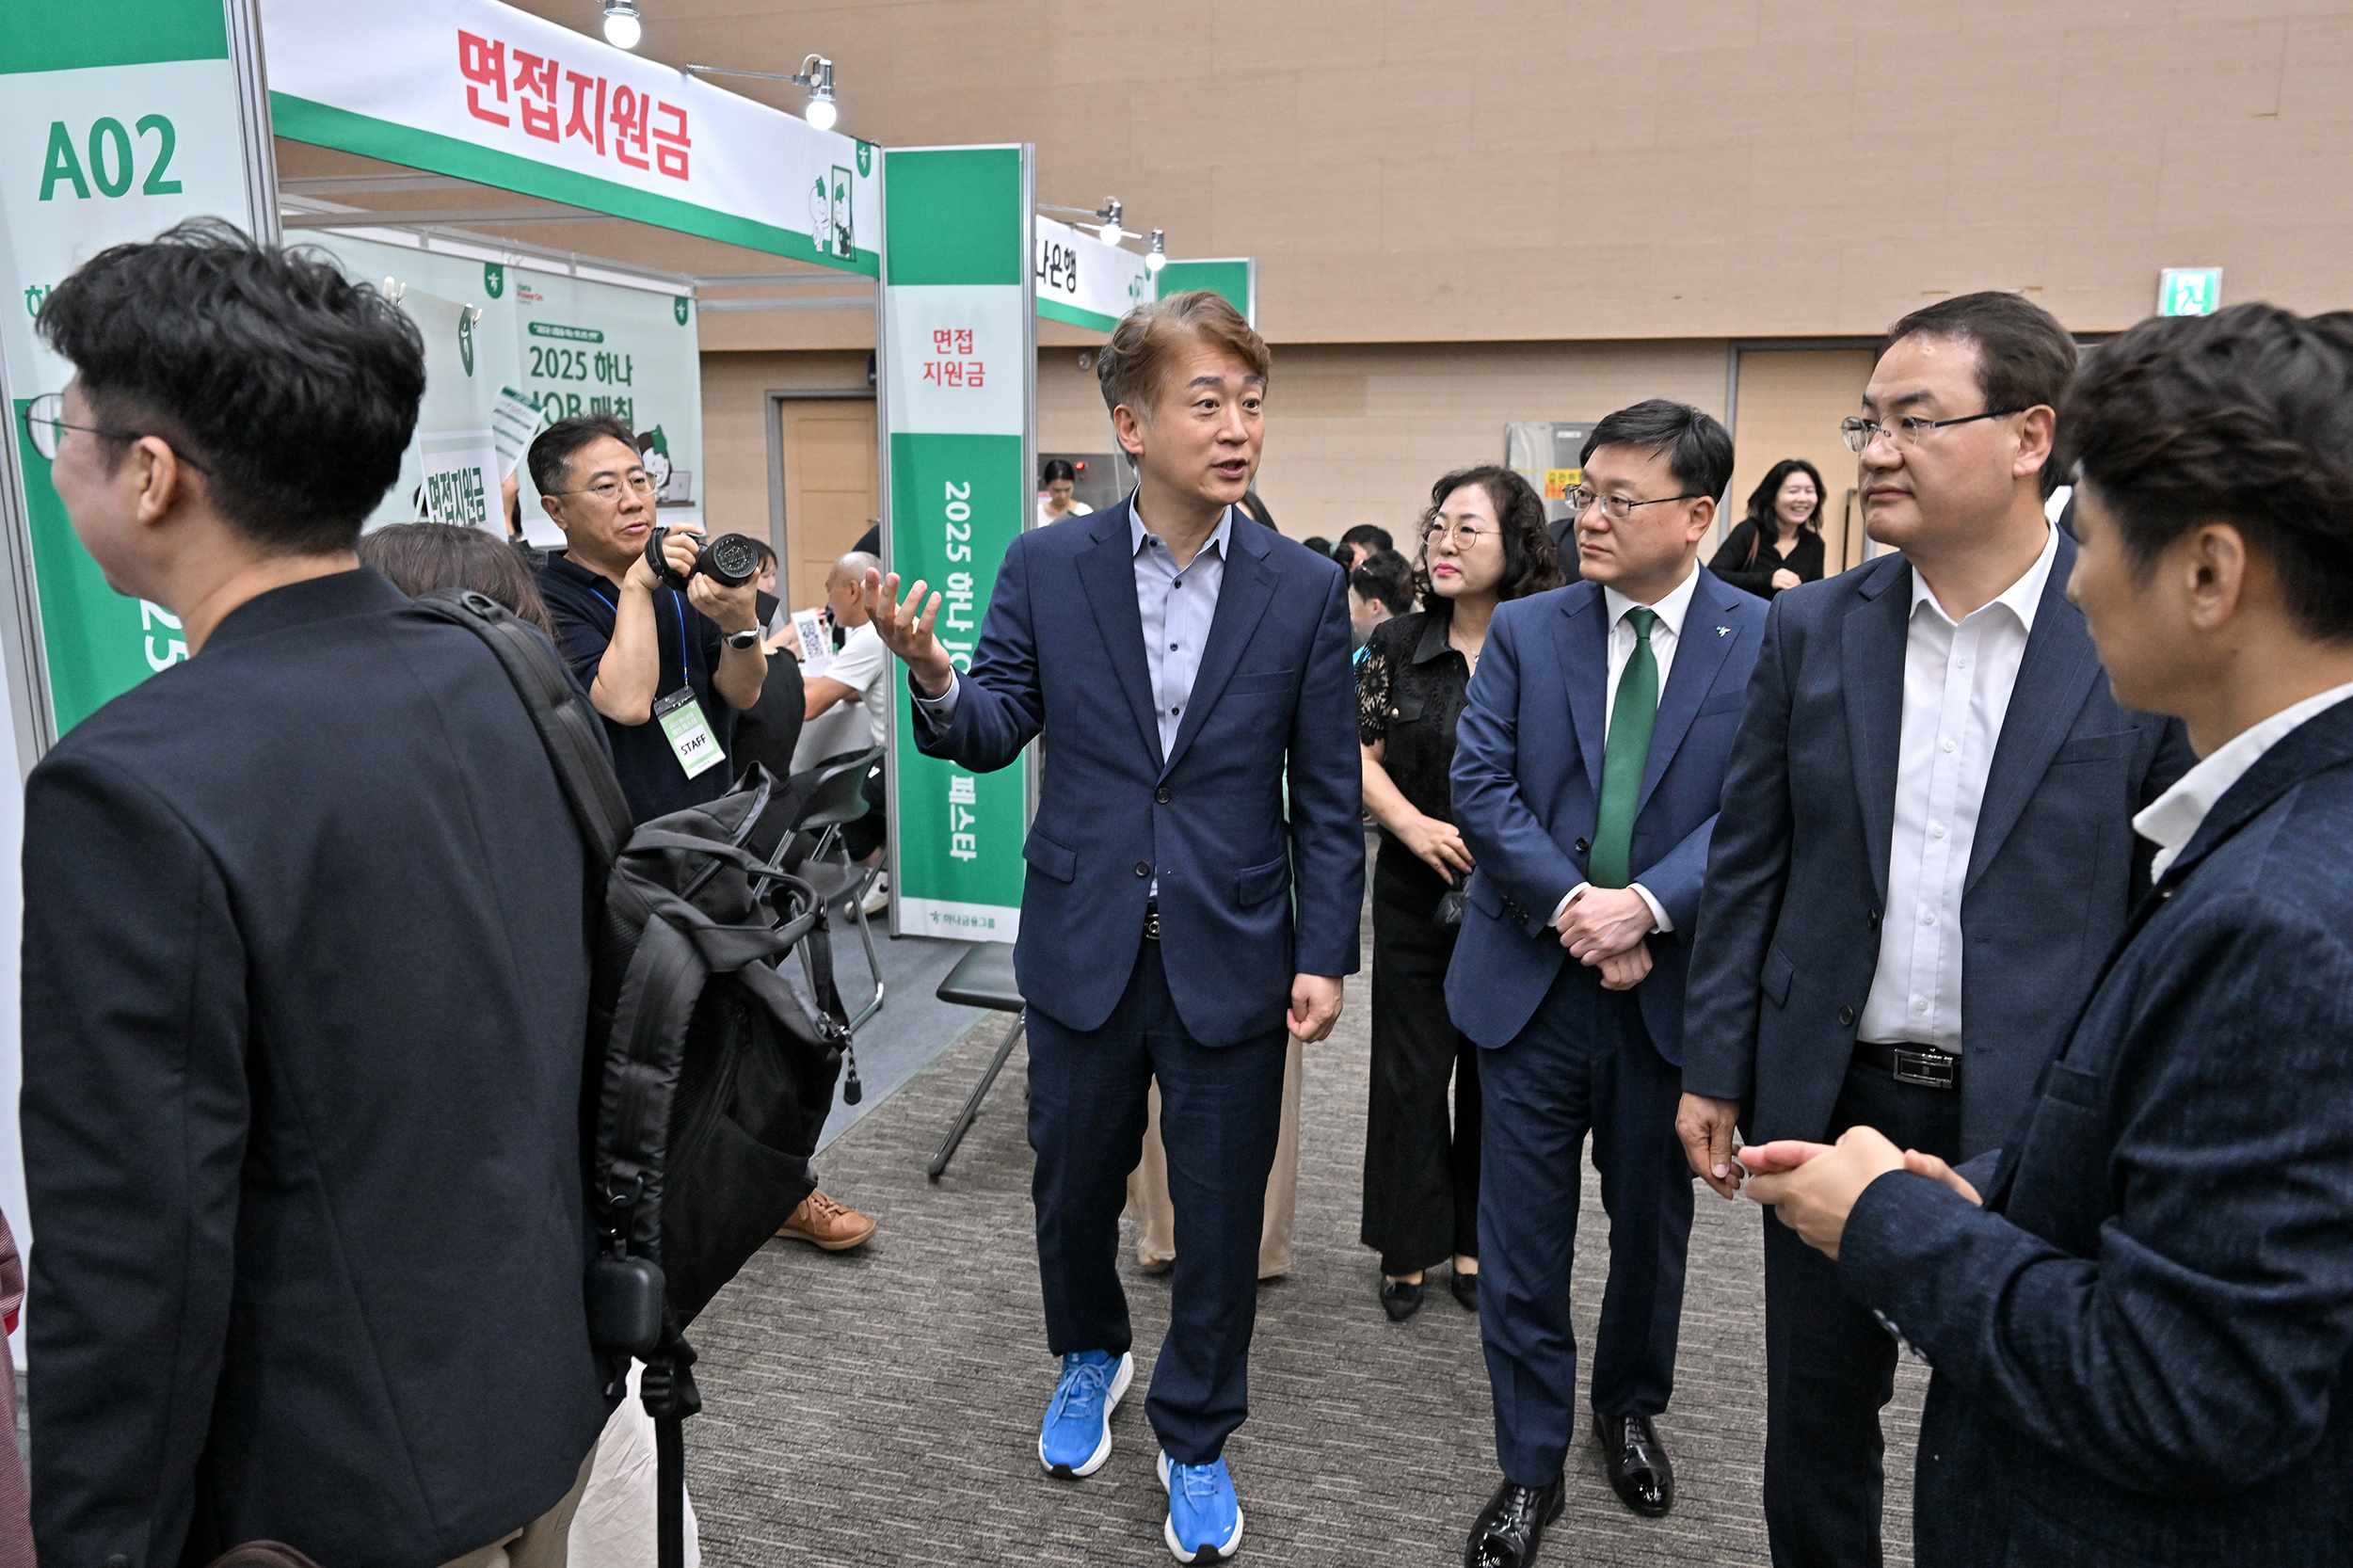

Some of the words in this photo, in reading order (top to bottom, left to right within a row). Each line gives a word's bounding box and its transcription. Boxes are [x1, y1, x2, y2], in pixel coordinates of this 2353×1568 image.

[457, 28, 691, 182] 면접지원금
[39, 113, 183, 201] A02
[1036, 239, 1076, 294] 나은행
[529, 345, 587, 381] 2025
[594, 351, 633, 387] 하나
[934, 328, 973, 355] 면접
[923, 361, 985, 387] 지원금
[428, 467, 487, 526] 면접지원금
[945, 481, 971, 562] 2025
[945, 571, 974, 632] 하나
[139, 598, 190, 672] 25
[942, 638, 973, 676] JO
[680, 733, 707, 756] STAFF
[949, 775, 977, 862] 페스타
